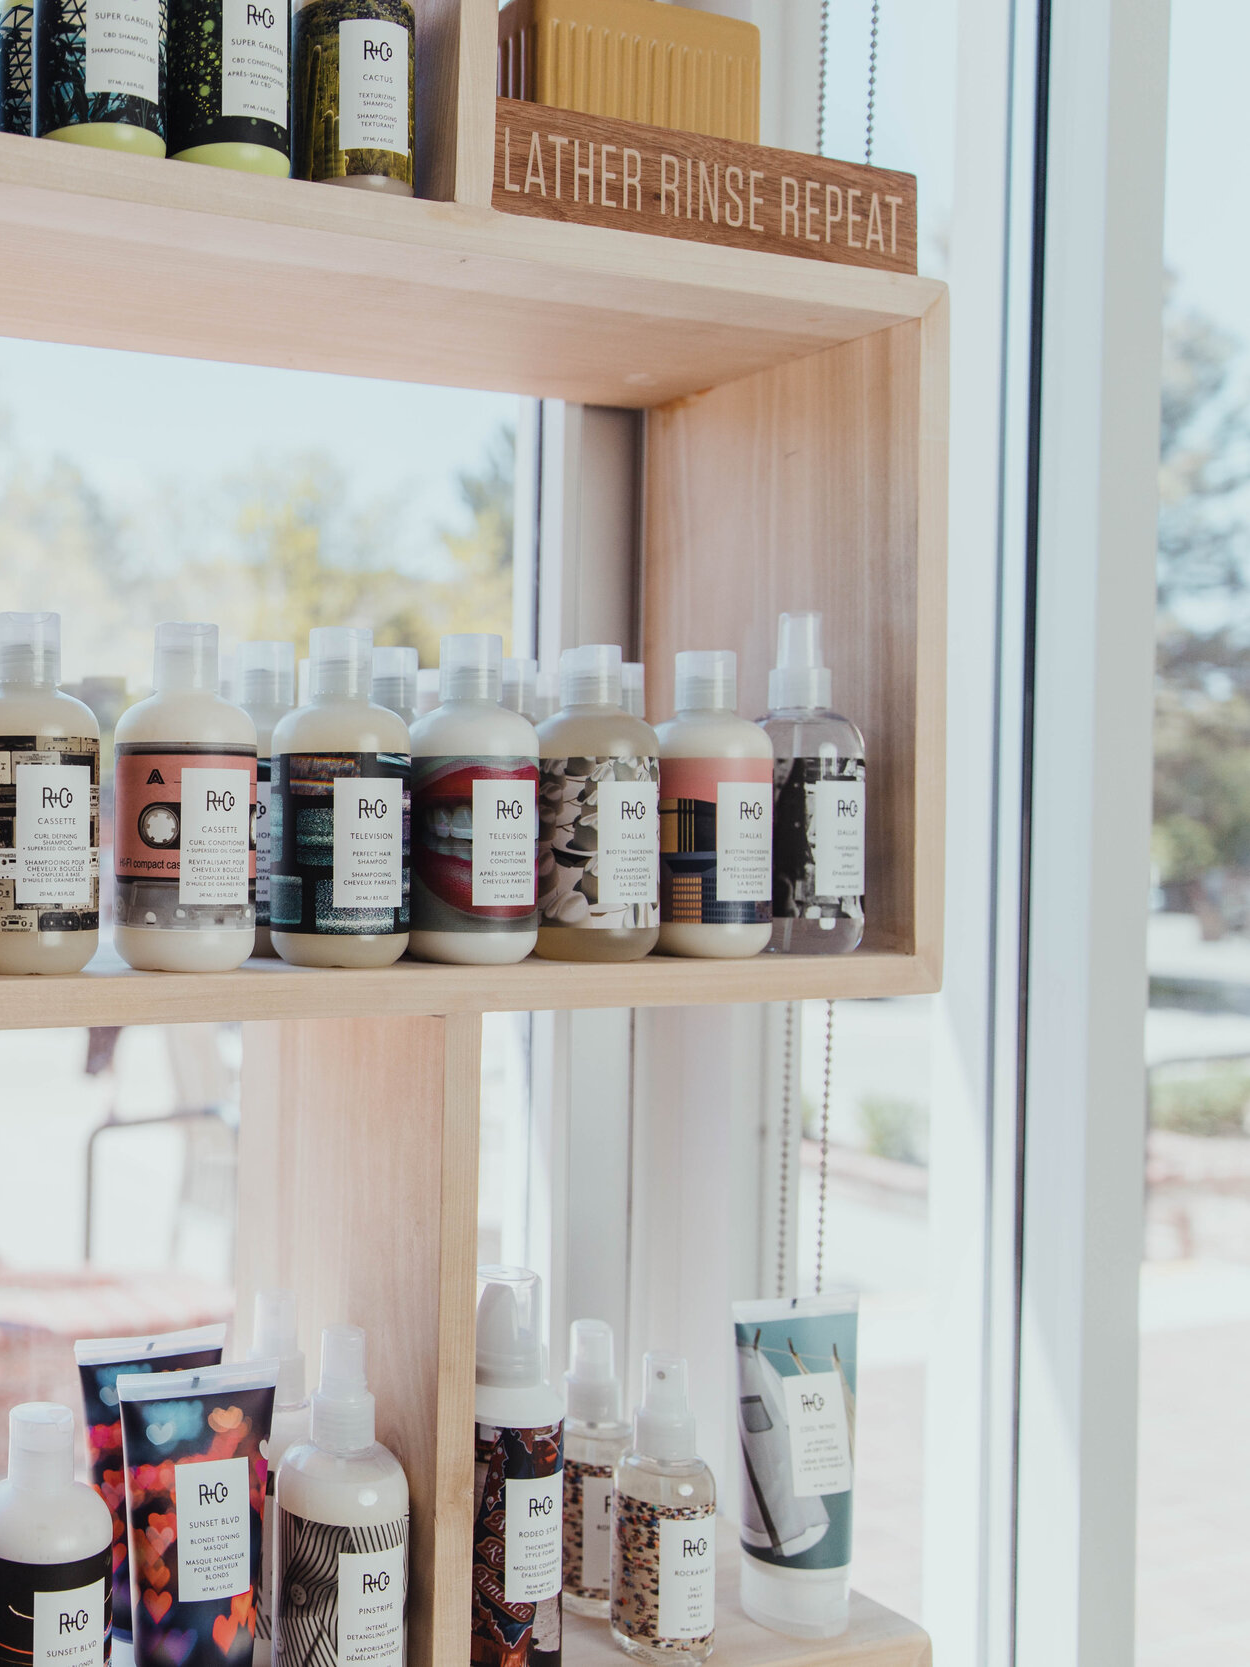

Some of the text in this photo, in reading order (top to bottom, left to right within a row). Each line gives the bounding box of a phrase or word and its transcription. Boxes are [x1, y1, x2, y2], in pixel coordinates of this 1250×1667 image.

[95, 12, 154, 29] SUPER GARDEN
[247, 4, 275, 29] R+Co
[118, 33, 148, 45] SHAMPOO
[91, 47, 136, 57] SHAMPOOING
[231, 38, 284, 57] SUPER GARDEN
[363, 40, 393, 62] R+Co
[362, 73, 393, 84] CACTUS
[358, 92, 397, 102] TEXTURIZING
[363, 100, 393, 109] SHAMPOO
[357, 113, 398, 123] SHAMPOOING
[361, 121, 395, 130] TEXTURANT
[504, 127, 903, 254] LATHER RINSE REPEAT
[146, 769, 165, 785] A
[42, 787, 73, 809] R+Co
[206, 790, 235, 812] R+Co
[358, 798, 387, 819] R+Co
[496, 800, 523, 820] R+Co
[621, 801, 646, 820] R+Co
[740, 801, 762, 820] R+Co
[37, 817, 76, 825] CASSETTE
[201, 826, 238, 834] CASSETTE
[351, 832, 393, 840] TELEVISION
[489, 832, 528, 840] TELEVISION
[621, 832, 646, 840] DALLAS
[739, 832, 762, 840] DALLAS
[133, 859, 164, 871] compact
[199, 1482, 228, 1506] R+Co
[529, 1495, 553, 1518] R+Co
[190, 1516, 240, 1529] SUNSET BLVD
[190, 1532, 240, 1545] BLONDE TONING
[518, 1529, 544, 1538] RODEO
[204, 1543, 229, 1552] MASQUE
[683, 1538, 707, 1558] R+Co
[186, 1558, 212, 1566] MASQUE
[213, 1562, 239, 1571] CHEVEUX
[513, 1563, 538, 1571] MOUSSE
[205, 1572, 229, 1580] BLONDS
[363, 1571, 390, 1594] R+Co
[358, 1602, 393, 1615] PINSTRIPE
[59, 1609, 89, 1635] R+Co
[366, 1622, 388, 1631] INTENSE
[347, 1630, 386, 1641] DETANGLING
[46, 1640, 97, 1658] SUNSET BLVD
